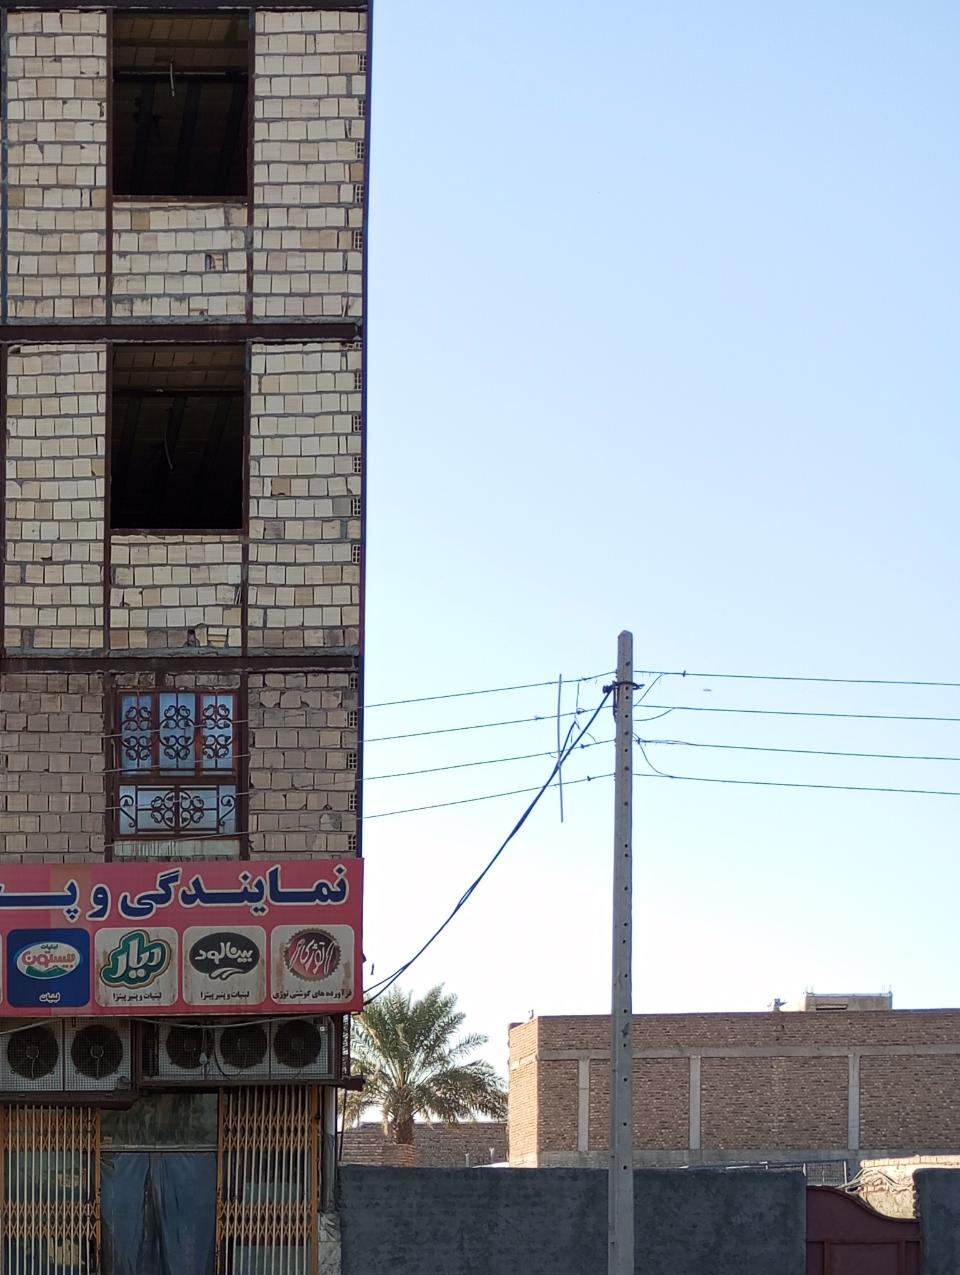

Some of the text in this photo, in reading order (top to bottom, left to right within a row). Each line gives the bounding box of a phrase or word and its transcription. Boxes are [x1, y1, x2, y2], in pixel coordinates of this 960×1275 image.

[86, 883, 111, 921] و
[120, 864, 349, 921] نمایندگی
[21, 951, 76, 968] بیستون
[194, 942, 254, 965] بینالود
[144, 992, 162, 1001] لبنیات
[231, 991, 250, 1000] لبنیات
